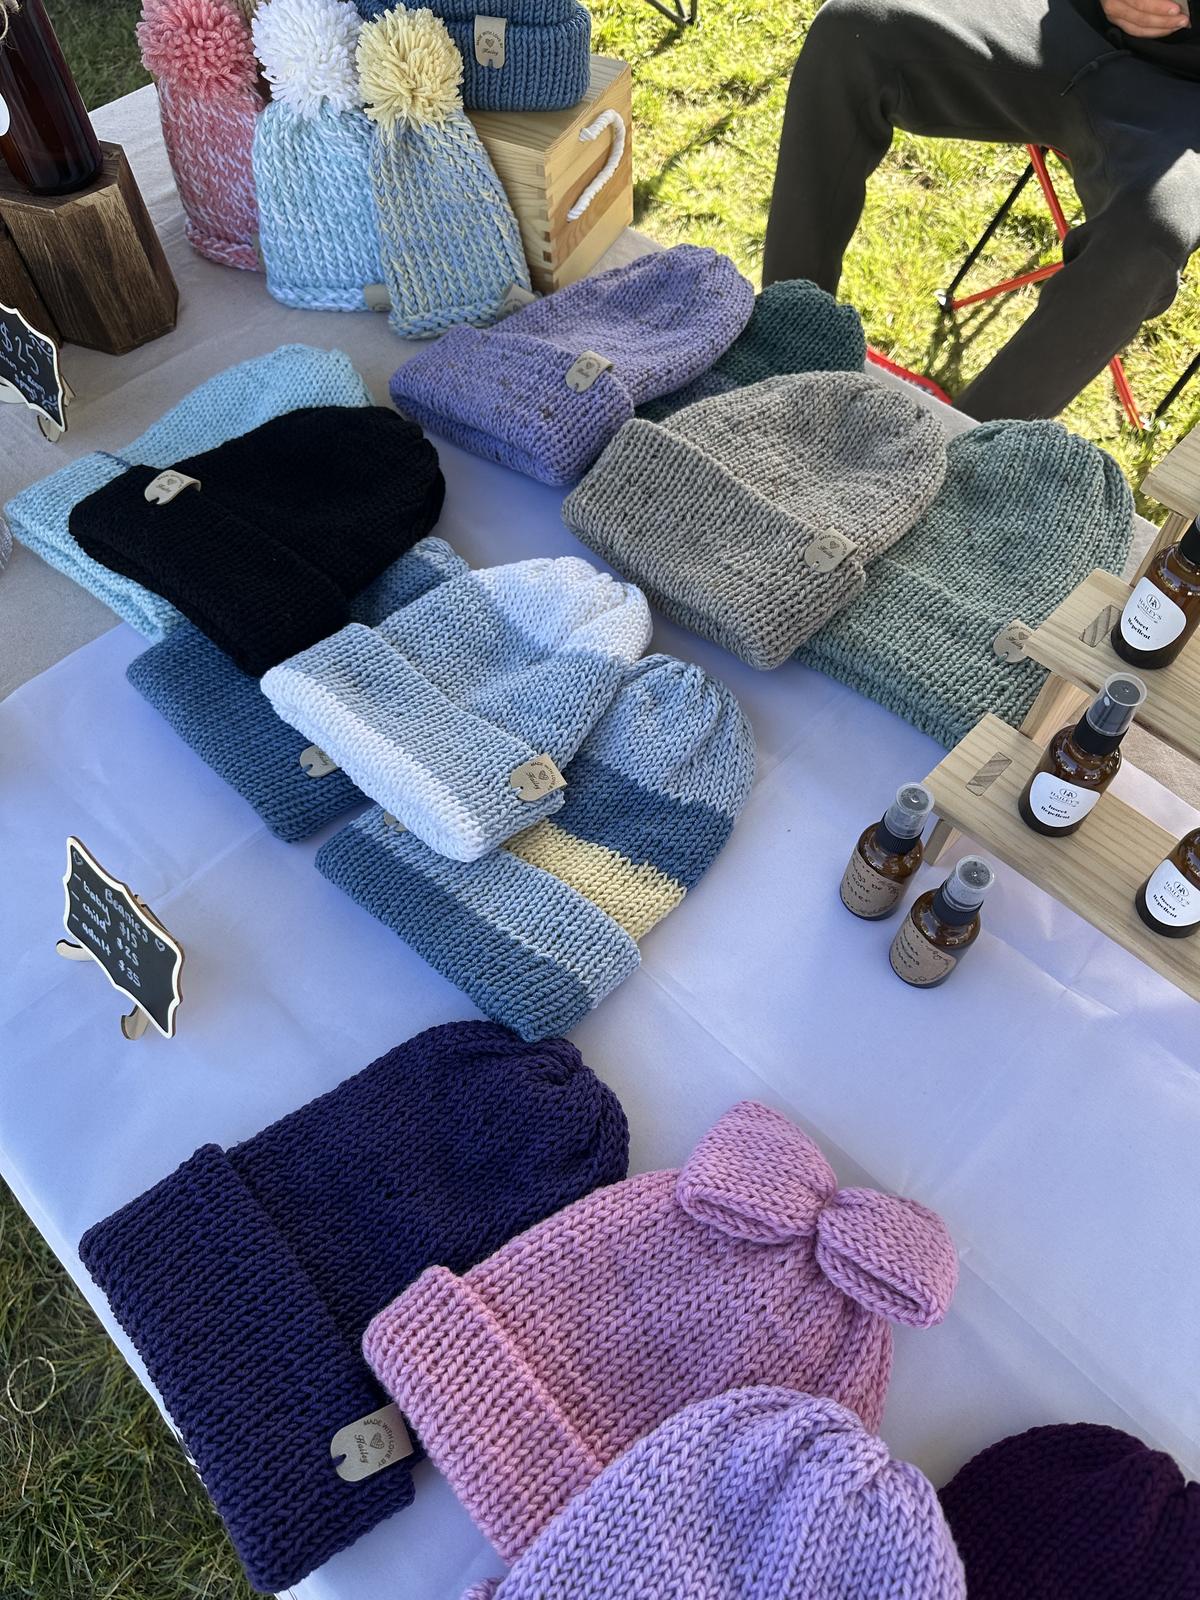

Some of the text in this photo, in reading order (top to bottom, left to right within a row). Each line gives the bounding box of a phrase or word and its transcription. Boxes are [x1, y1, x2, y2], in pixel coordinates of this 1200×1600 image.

[0, 321, 39, 375] $25
[1127, 617, 1151, 640] Repellent
[1133, 615, 1149, 631] Insect
[1041, 805, 1070, 820] Repellent
[1048, 804, 1067, 814] Insect
[83, 880, 137, 948] baby $15
[1153, 894, 1177, 918] Repellent
[1160, 895, 1176, 911] Insect
[105, 888, 148, 943] Beanies
[82, 903, 139, 966] child $25
[82, 922, 141, 988] adult $35
[354, 1434, 368, 1463] Hailey
[385, 1440, 395, 1459] LOVE
